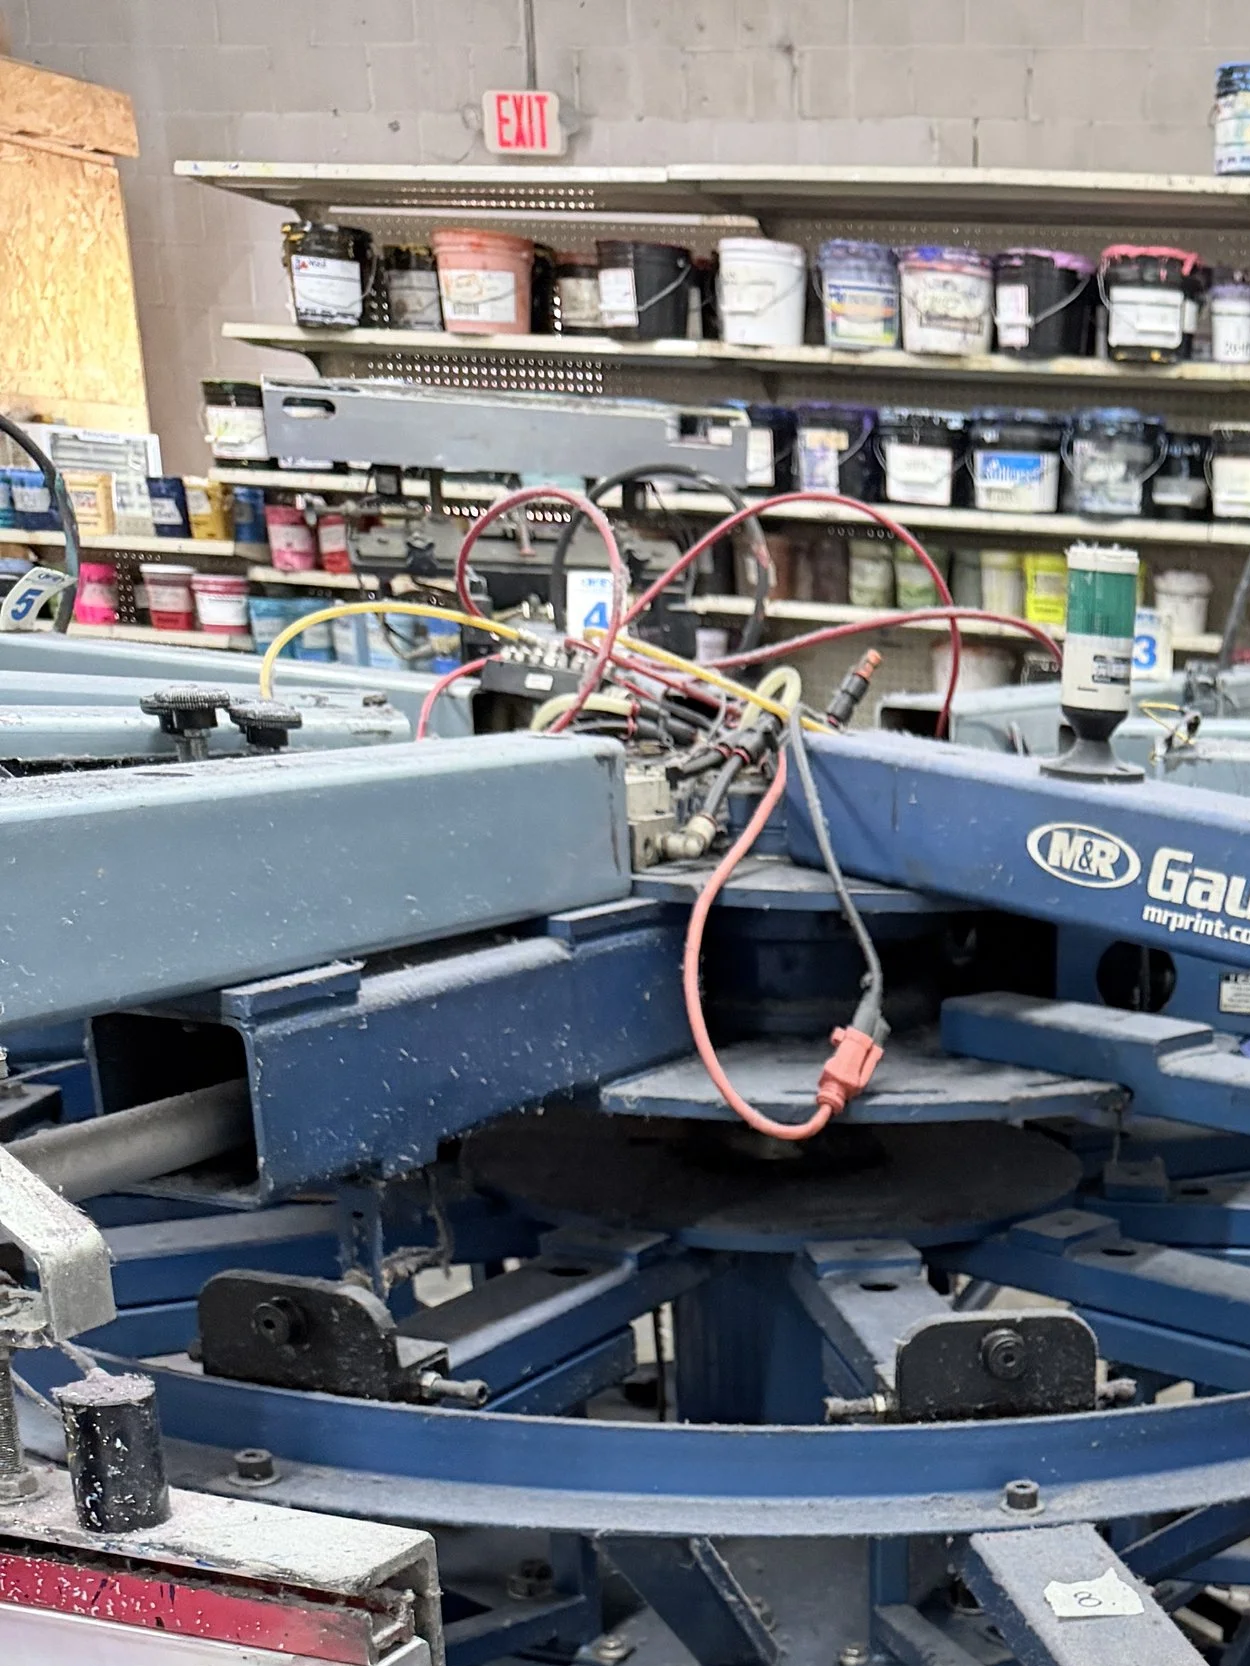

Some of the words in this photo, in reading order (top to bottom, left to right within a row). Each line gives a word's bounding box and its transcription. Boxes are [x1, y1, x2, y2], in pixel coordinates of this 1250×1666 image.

[496, 94, 548, 149] EXIT
[11, 588, 44, 621] 5
[584, 602, 609, 629] 4
[1133, 635, 1156, 669] 3
[1048, 829, 1120, 881] M&R
